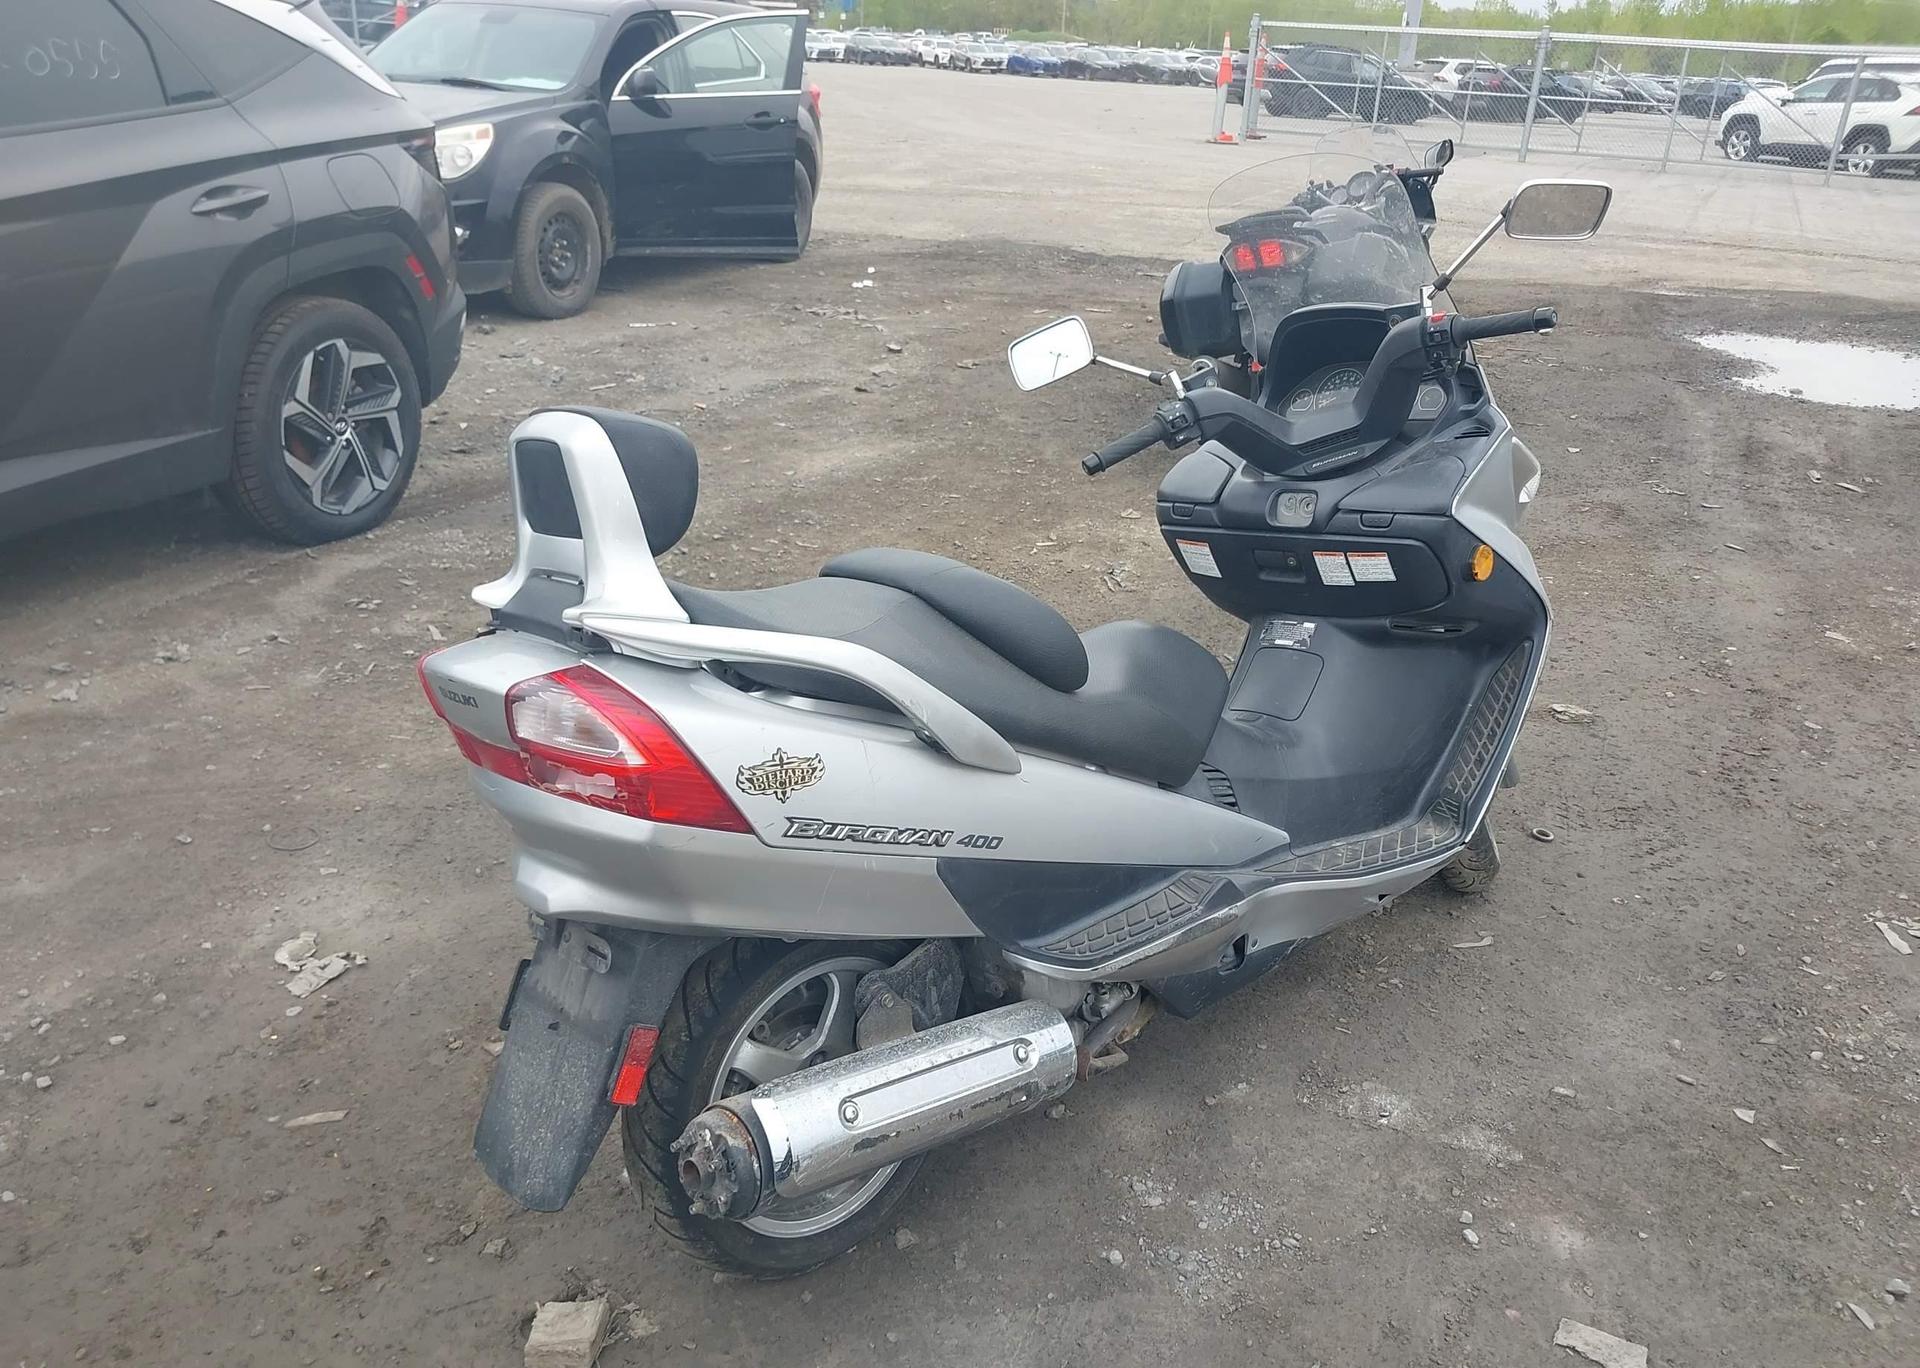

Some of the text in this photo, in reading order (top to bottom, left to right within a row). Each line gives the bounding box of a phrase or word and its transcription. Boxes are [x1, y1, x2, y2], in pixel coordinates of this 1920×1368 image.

[438, 686, 479, 709] SUZUKI
[752, 767, 813, 784] DIEHARD
[754, 774, 813, 791] DISCIPLE
[782, 816, 1004, 850] BURGMAN 400
